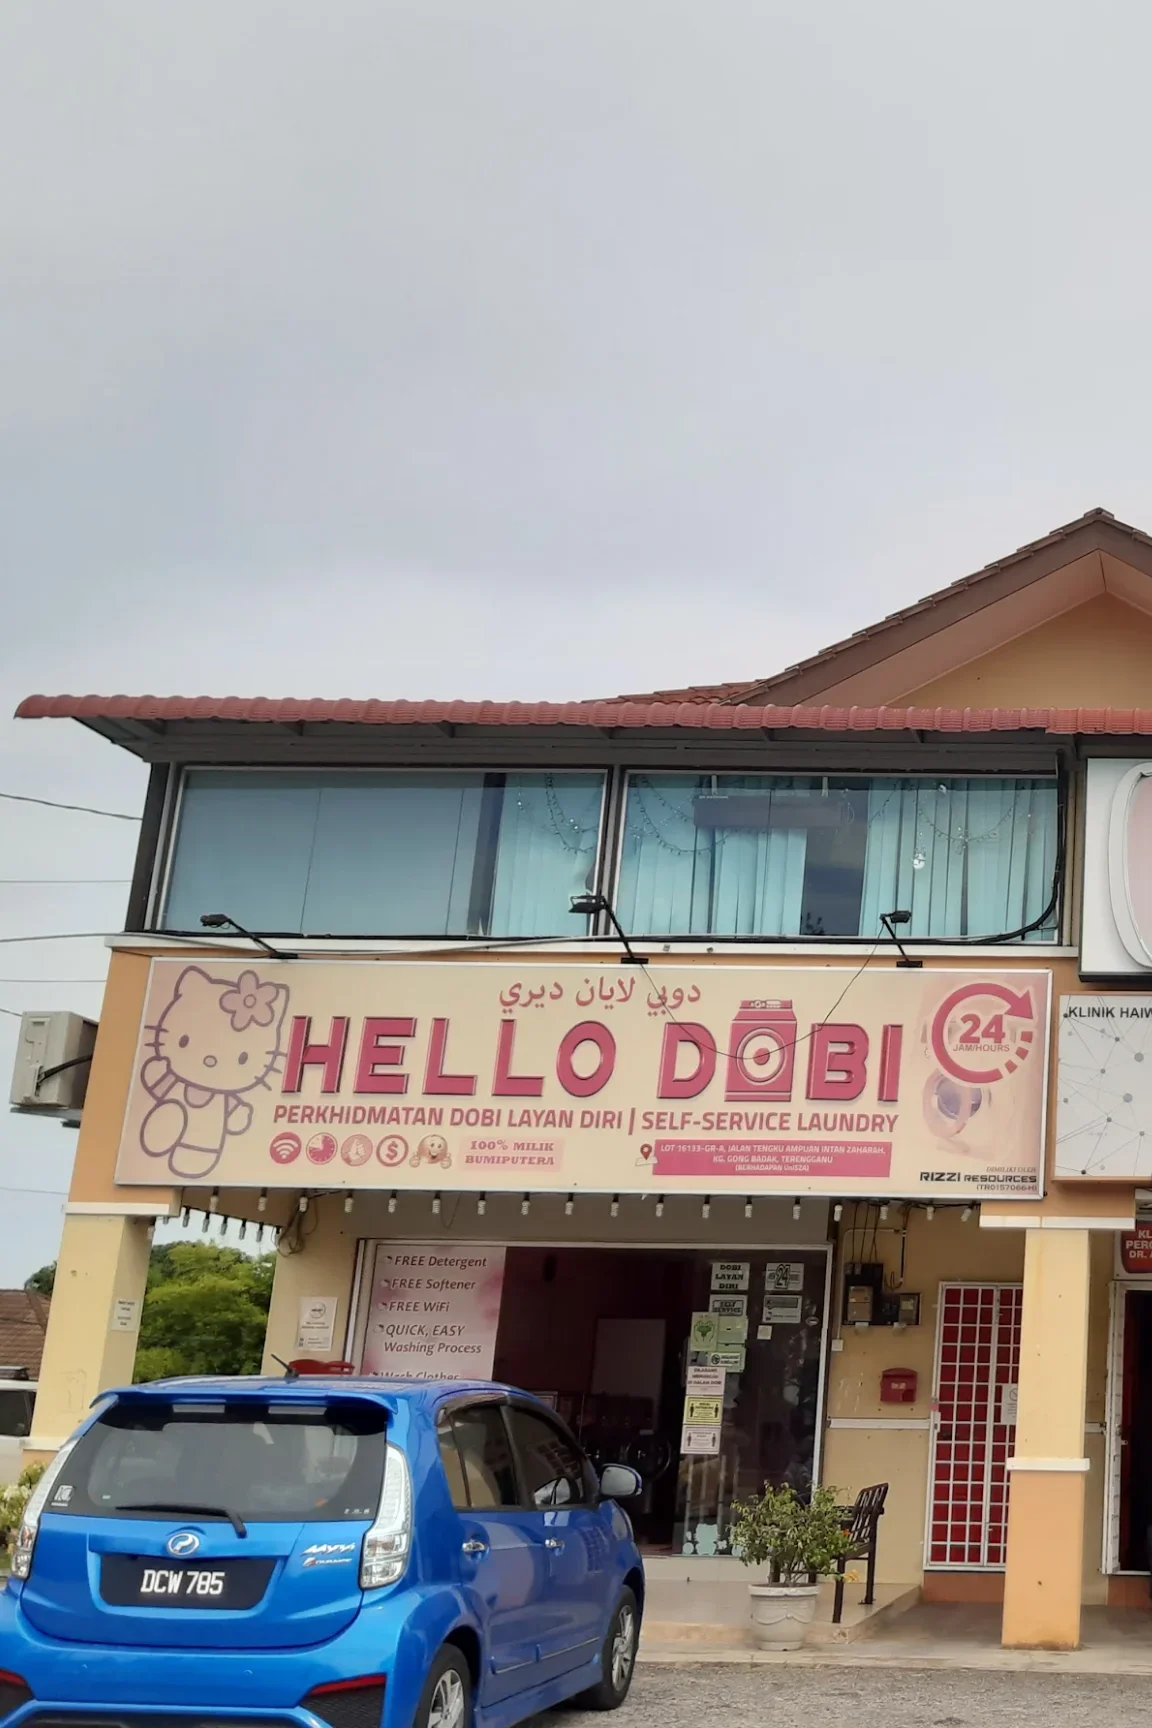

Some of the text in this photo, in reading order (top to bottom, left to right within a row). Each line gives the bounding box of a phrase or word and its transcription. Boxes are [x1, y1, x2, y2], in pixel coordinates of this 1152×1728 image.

[499, 976, 701, 1017] دوبي لايان ديري
[1068, 1006, 1115, 1018] KLINIK
[959, 1014, 1005, 1044] 24
[952, 1044, 1010, 1052] JAM/HOURS
[280, 1015, 617, 1098] HELLO
[273, 1104, 444, 1128] PERKHIDMATAN
[450, 1107, 502, 1128] DOBI
[507, 1108, 574, 1129] LAYAN
[579, 1109, 622, 1130] DIRI
[641, 1111, 791, 1132] SELF-SERVICE
[797, 1112, 899, 1133] LAUNDRY
[470, 1140, 554, 1152] 100% MILIK
[661, 1144, 676, 1152] LOT
[728, 1145, 752, 1153] JALAN
[753, 1145, 784, 1153] TENGKU
[785, 1145, 820, 1153] AMPUAN
[465, 1155, 555, 1165] BUMIPUTERA
[727, 1155, 751, 1163] GONG
[781, 1155, 833, 1163] TERENGGANU
[920, 1172, 1037, 1183] RIZZI RESOURCES
[394, 1256, 487, 1270] FREE Detergent
[391, 1279, 476, 1290] FREE Softener
[389, 1301, 450, 1312] FREE WiFi
[385, 1324, 466, 1338] QUICK, EASY
[384, 1342, 482, 1356] Washing Process
[140, 1569, 225, 1595] DCW 785
